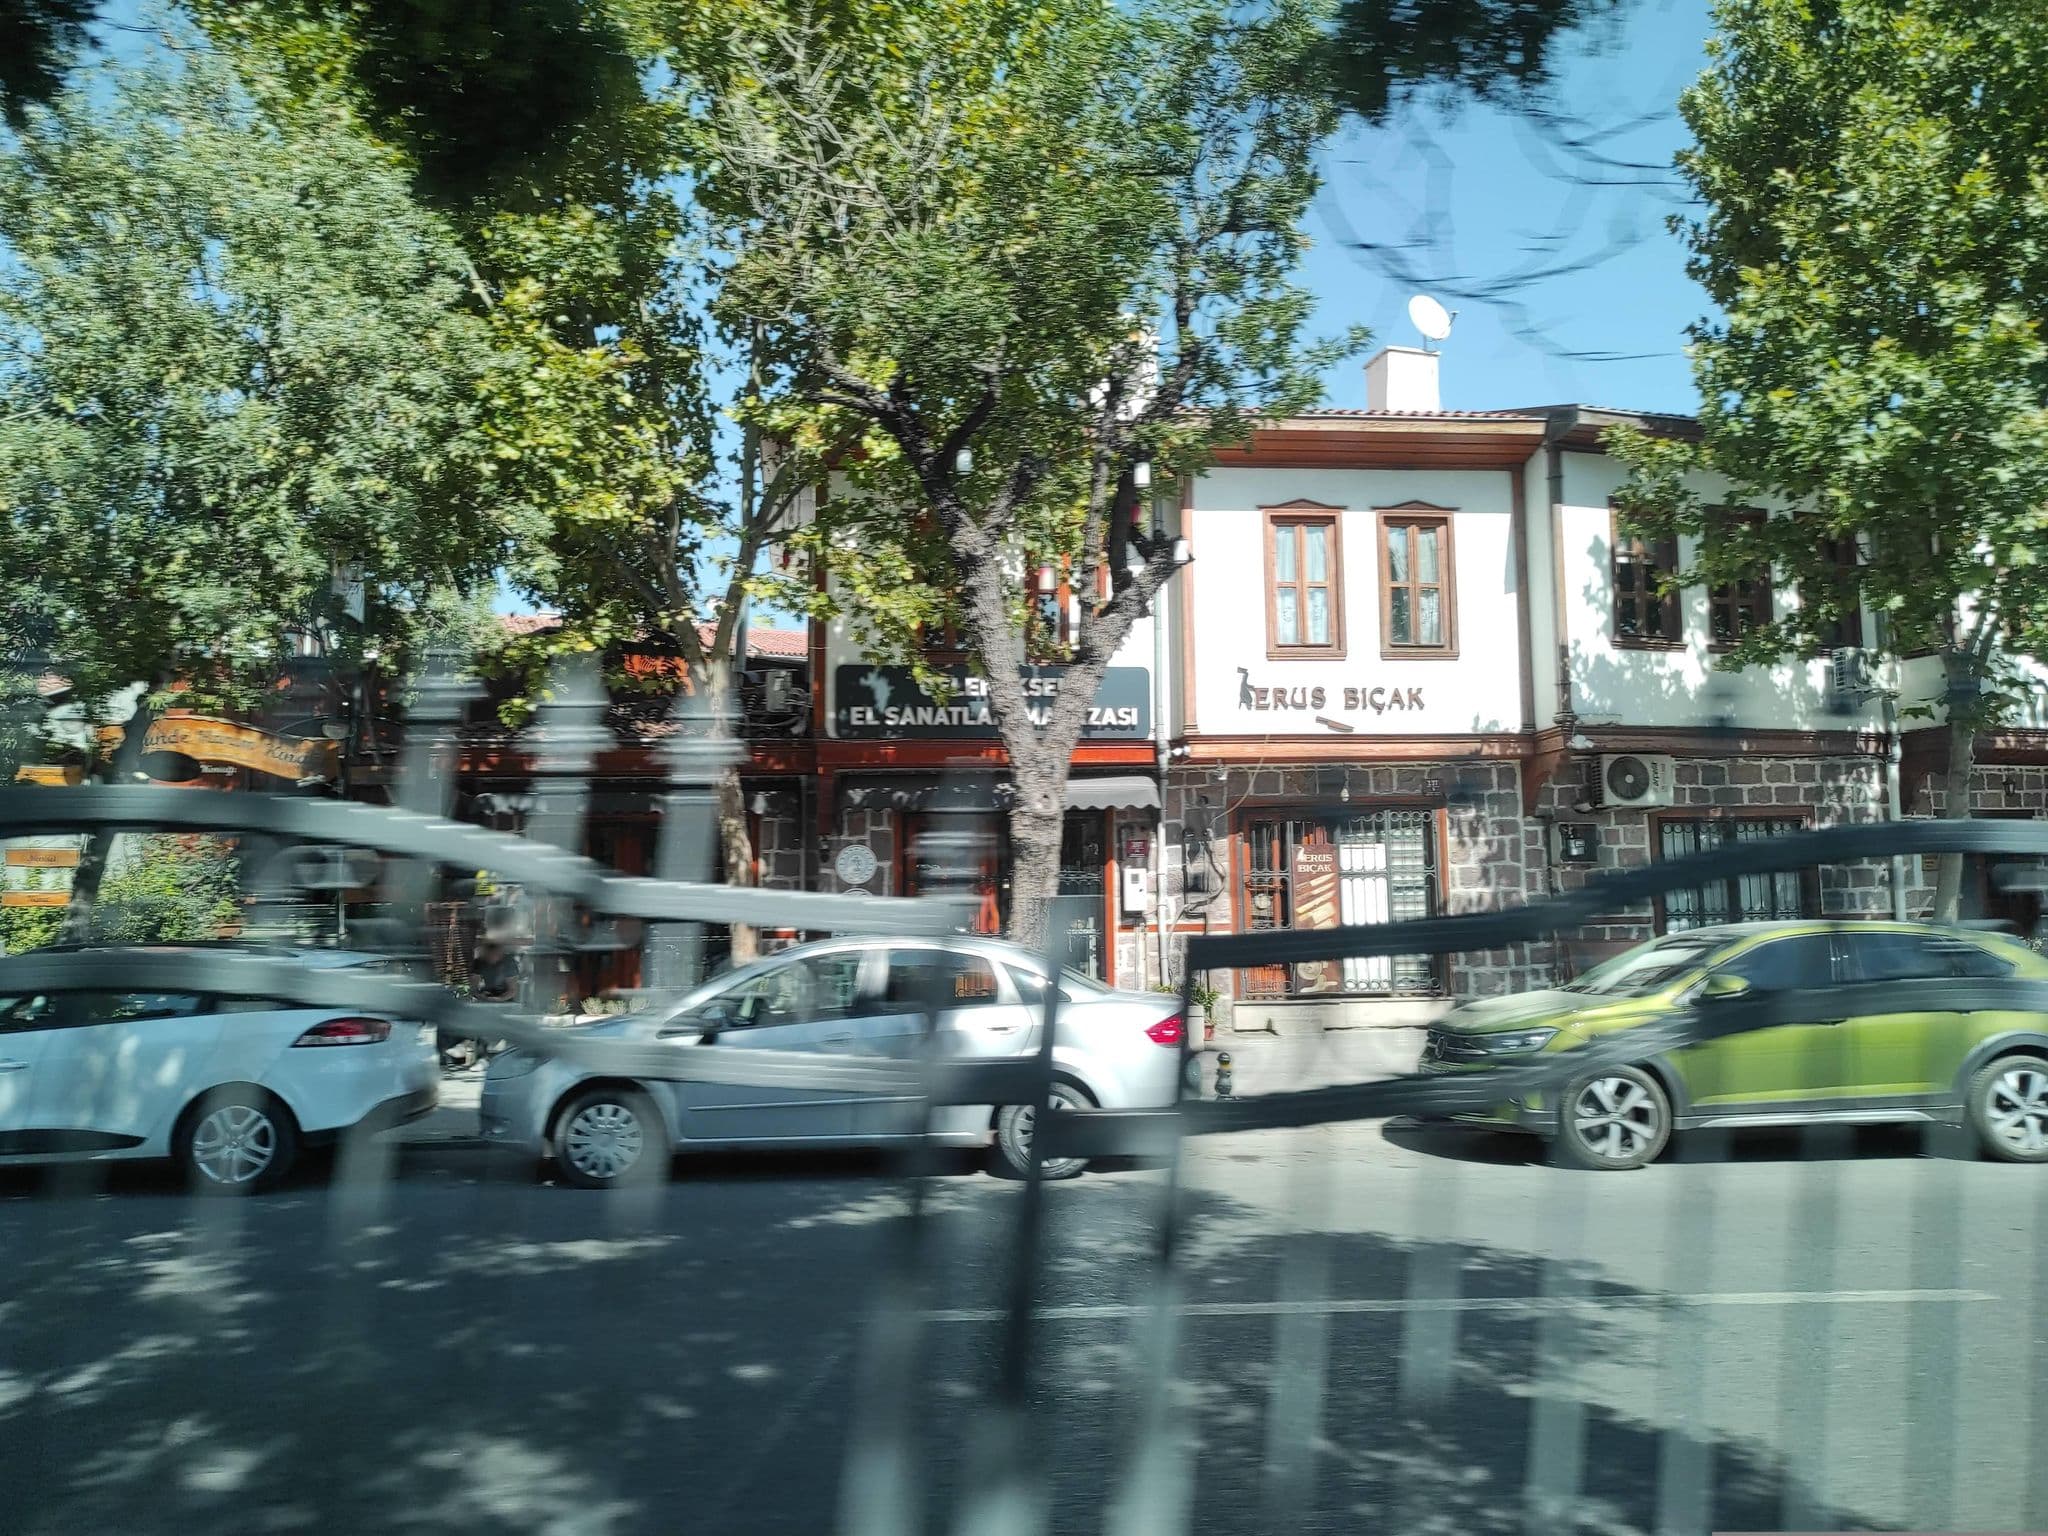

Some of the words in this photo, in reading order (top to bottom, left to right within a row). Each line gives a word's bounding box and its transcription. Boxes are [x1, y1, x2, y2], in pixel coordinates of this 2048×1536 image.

[1343, 686, 1425, 716] BIÇAK
[850, 706, 881, 726] EL
[883, 705, 1003, 726] SANATLA
